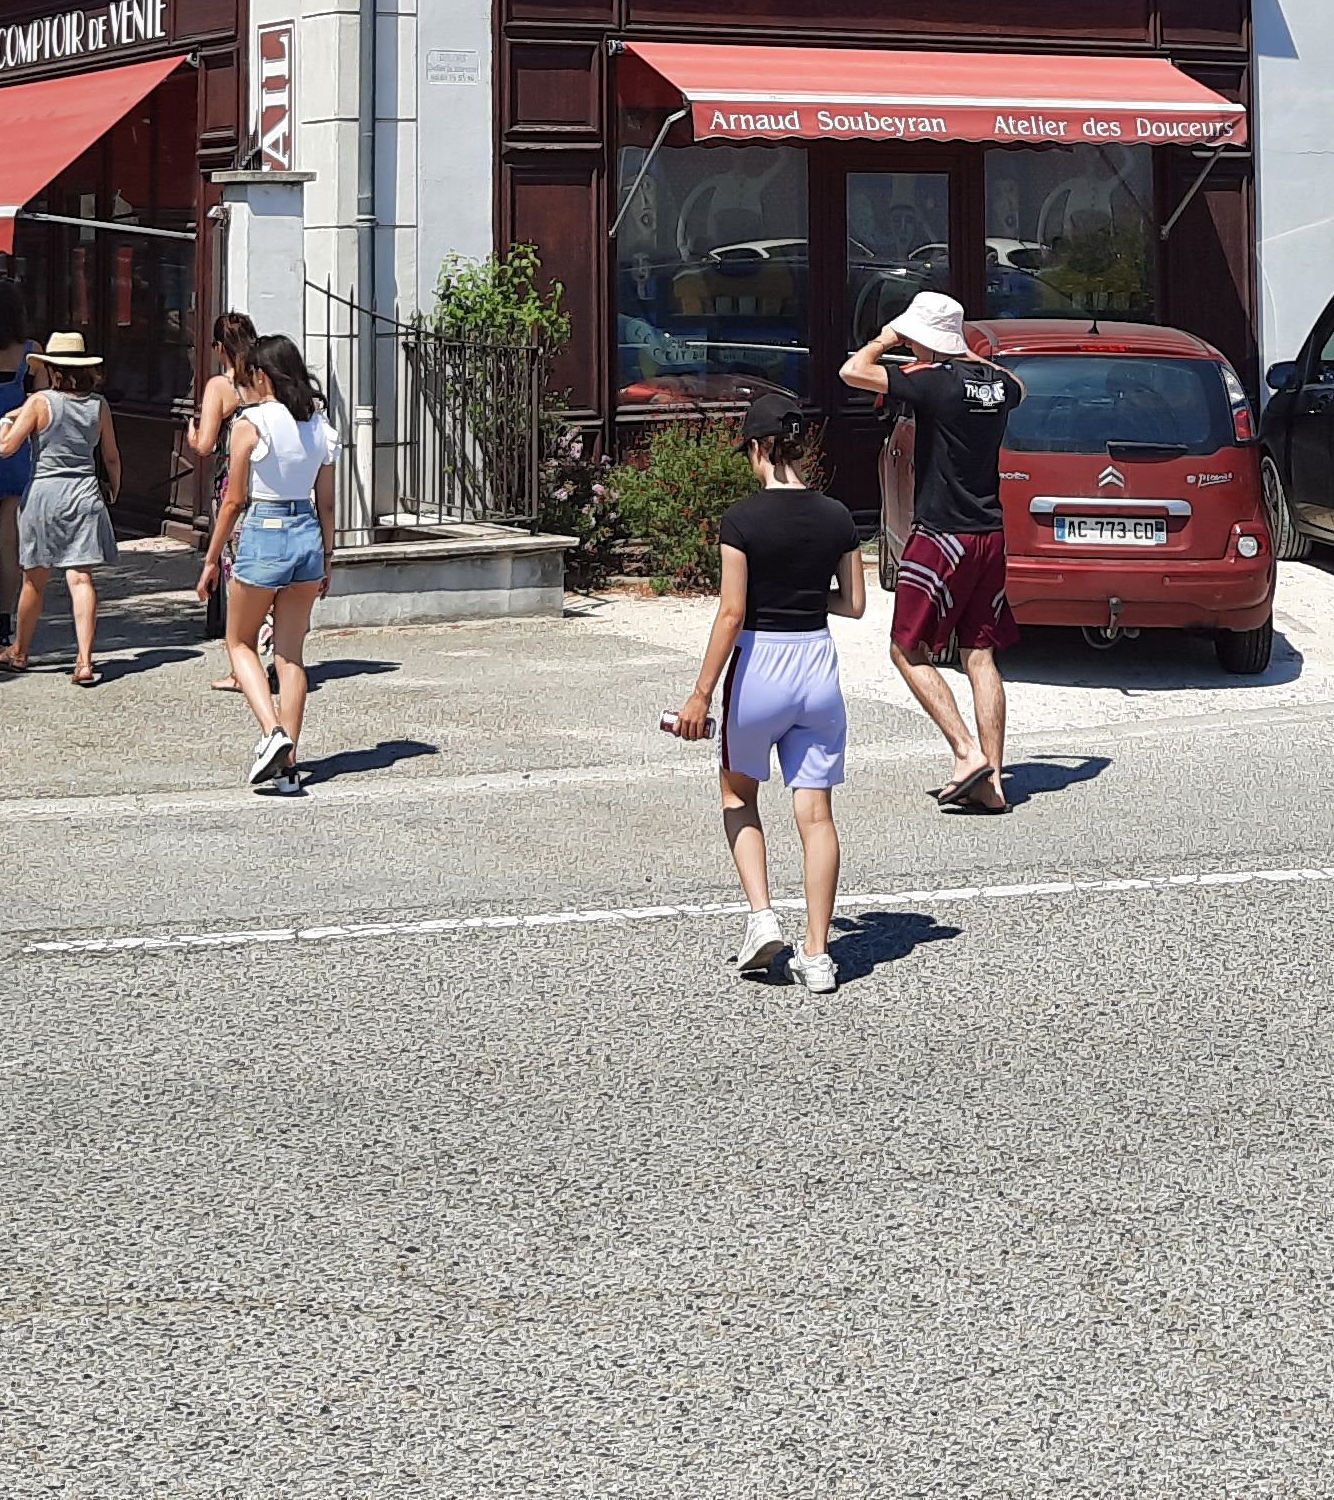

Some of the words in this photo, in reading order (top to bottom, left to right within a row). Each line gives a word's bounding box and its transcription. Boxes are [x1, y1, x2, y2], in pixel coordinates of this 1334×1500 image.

[88, 15, 108, 51] DE
[262, 32, 289, 172] AIL
[709, 110, 800, 133] Arnaud
[817, 110, 947, 138] Soubeyran
[993, 115, 1068, 137] Atelier
[1082, 117, 1122, 138] des
[1136, 117, 1234, 139] Douceurs
